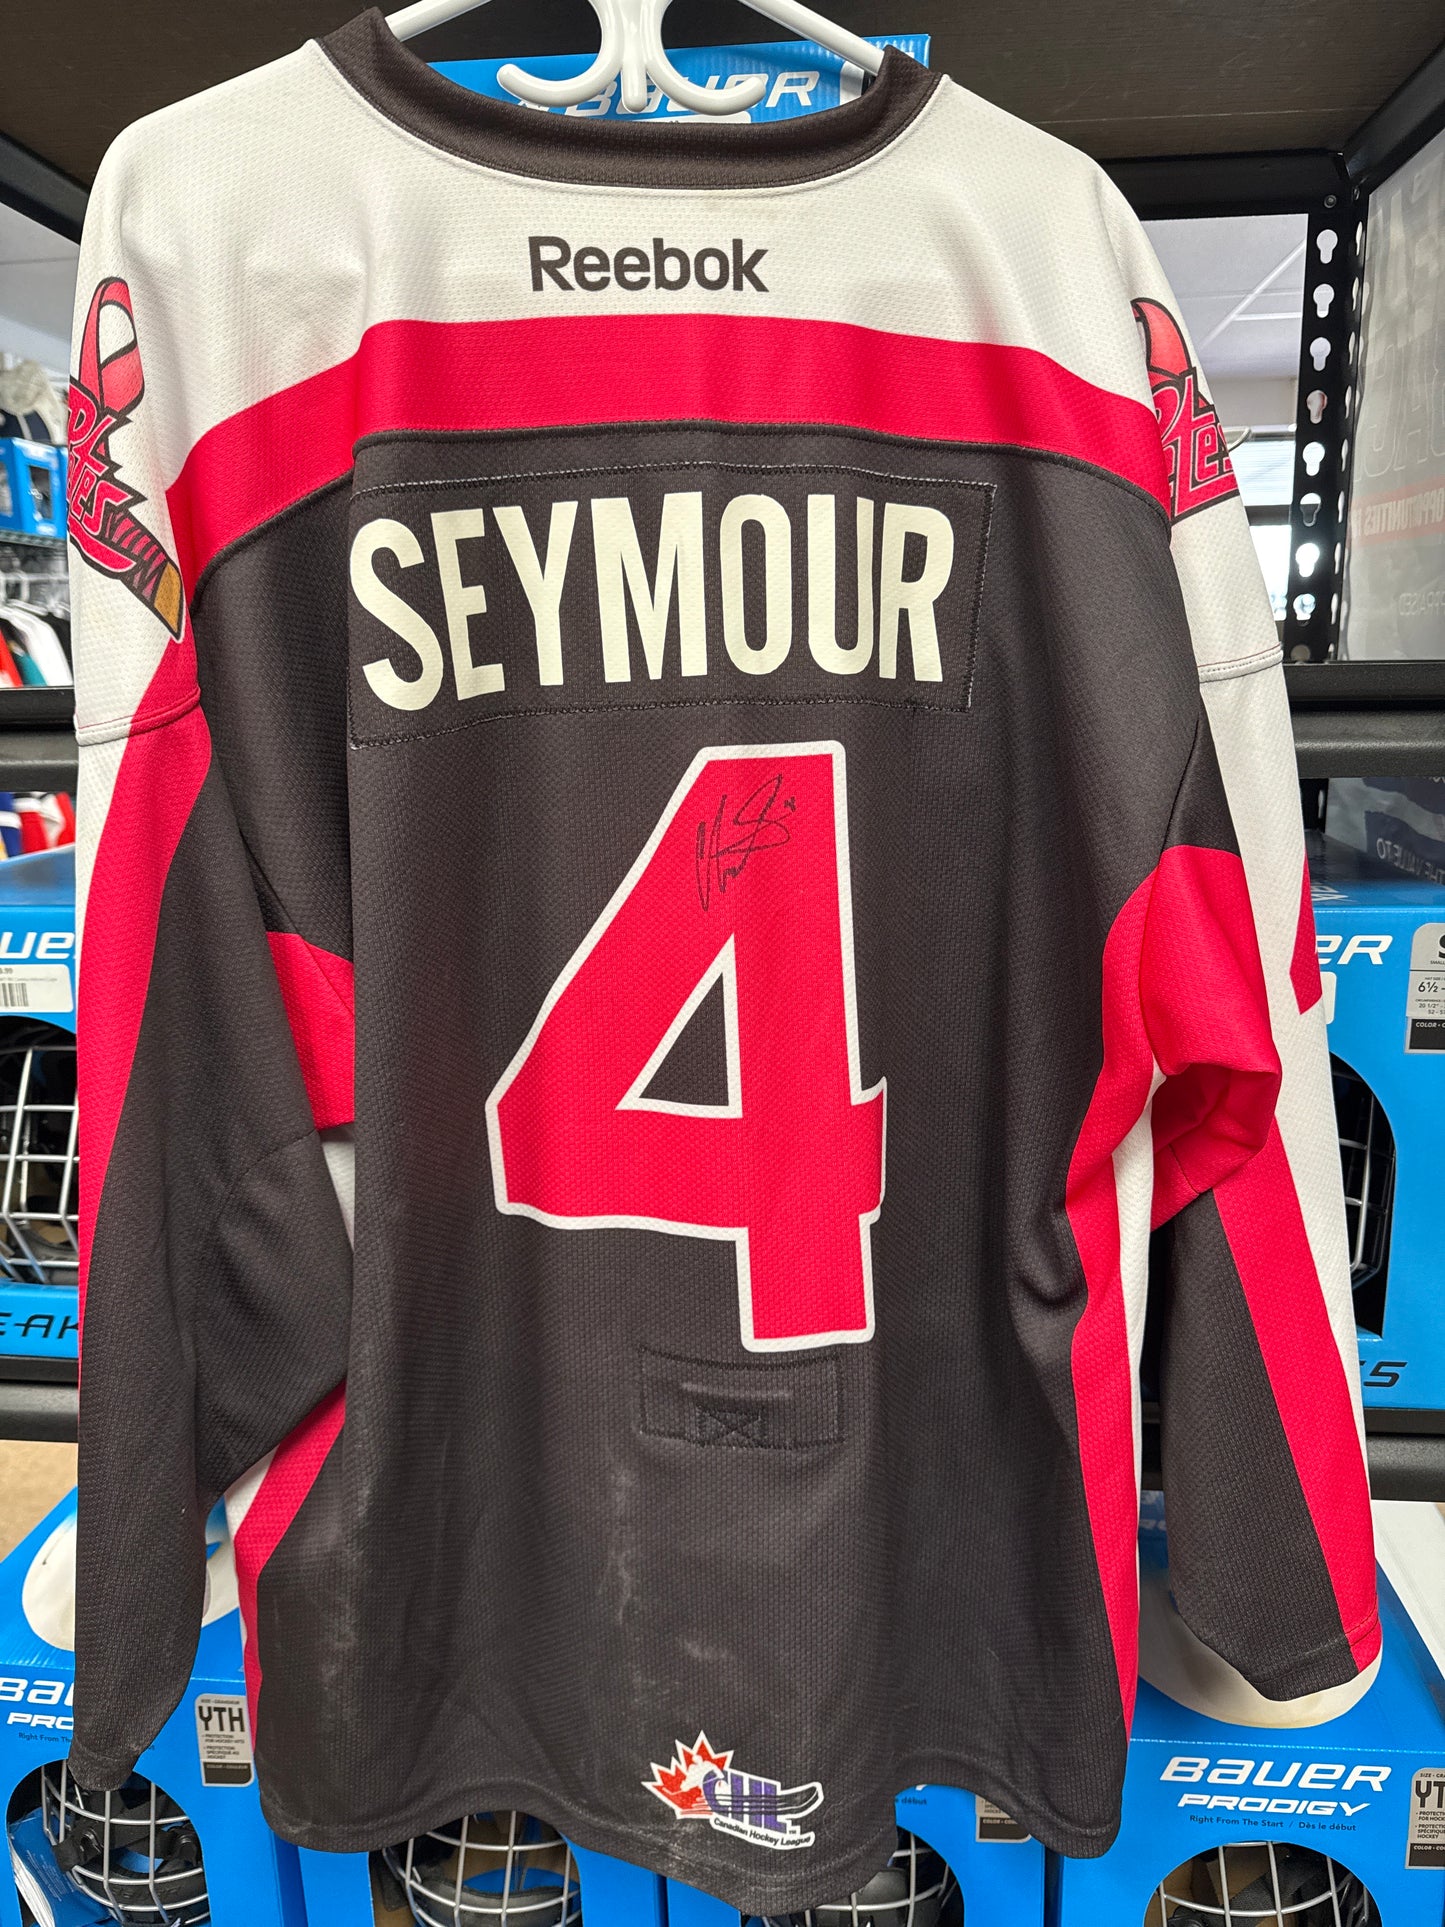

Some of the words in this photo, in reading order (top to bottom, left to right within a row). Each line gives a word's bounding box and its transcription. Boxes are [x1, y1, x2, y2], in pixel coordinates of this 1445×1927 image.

[528, 236, 769, 292] Reebok
[350, 491, 954, 711] SEYMOUR
[484, 739, 888, 1352] 4
[198, 1705, 245, 1732] YTH
[1160, 1756, 1392, 1792] BAUER
[1177, 1793, 1371, 1817] PRODIGY
[713, 1817, 748, 1836] Canadian
[749, 1829, 780, 1846] Hockey
[780, 1836, 812, 1847] League
[1189, 1814, 1214, 1825] Right
[1216, 1816, 1240, 1825] From
[1242, 1818, 1259, 1827] The
[1261, 1819, 1284, 1828] Start
[1298, 1821, 1316, 1830] Dès
[1318, 1822, 1326, 1830] le
[1329, 1823, 1356, 1832] début
